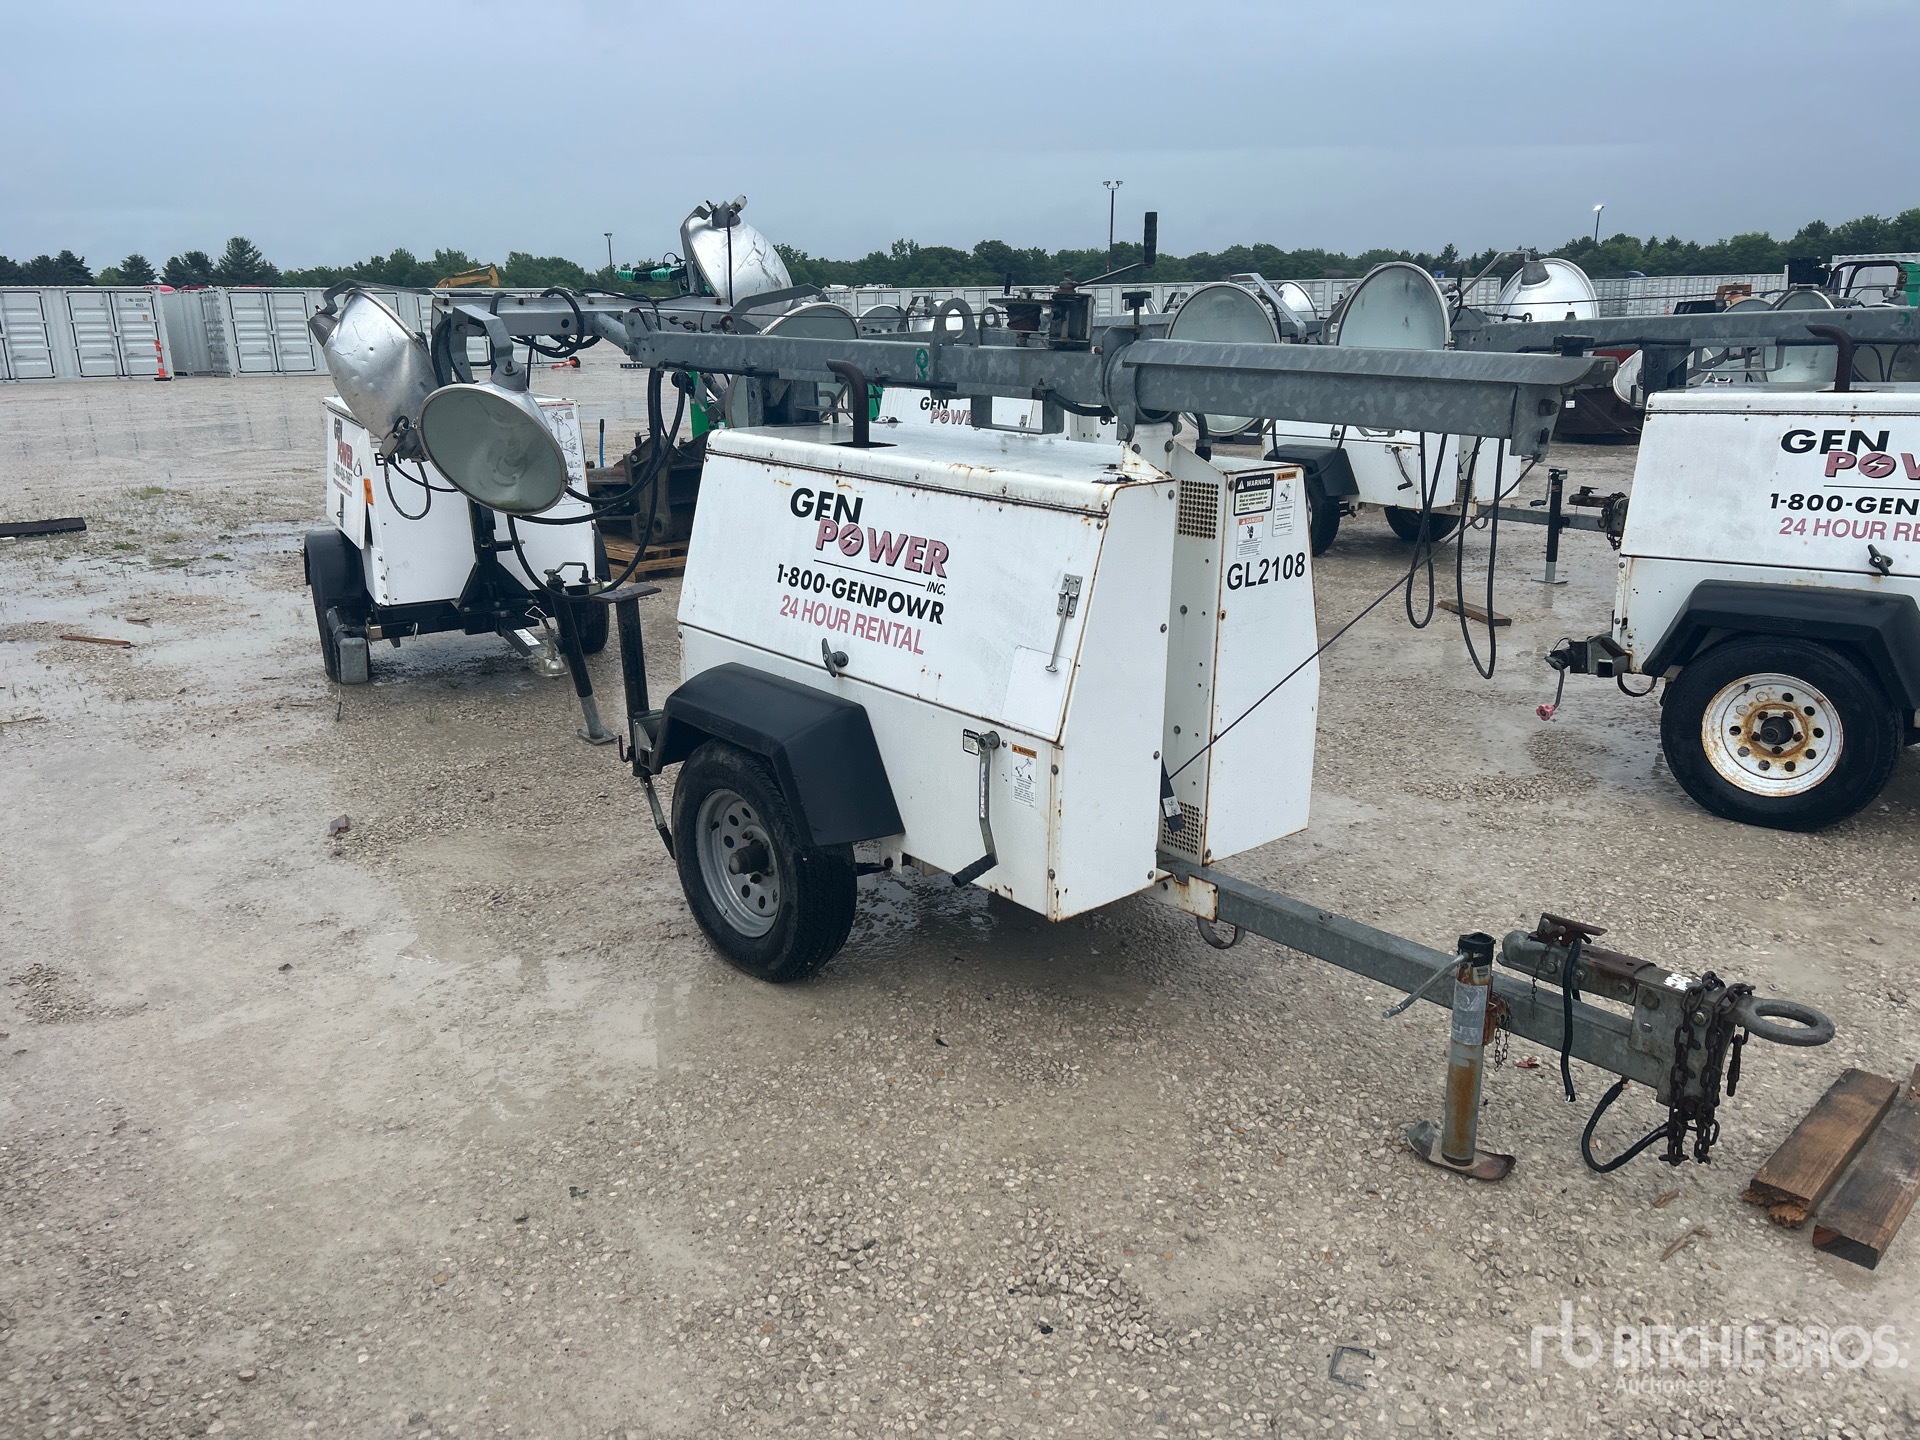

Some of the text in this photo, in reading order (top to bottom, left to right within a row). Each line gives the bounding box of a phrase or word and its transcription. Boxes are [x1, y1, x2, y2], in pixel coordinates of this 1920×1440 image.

[920, 397, 949, 411] GEN
[930, 407, 972, 425] POWE
[1780, 429, 1890, 455] GEN
[1246, 477, 1271, 488] WARNING
[790, 487, 864, 525] GEN
[1770, 493, 1920, 516] 1-800-GEN
[1779, 516, 1807, 536] 24
[1812, 518, 1888, 540] HOUR
[815, 517, 950, 580] POWER
[1227, 552, 1306, 590] GL2108
[776, 563, 945, 626] 1-800-GENPOWR
[926, 581, 947, 597] INC.
[779, 594, 925, 656] 24 HOUR RENTAL
